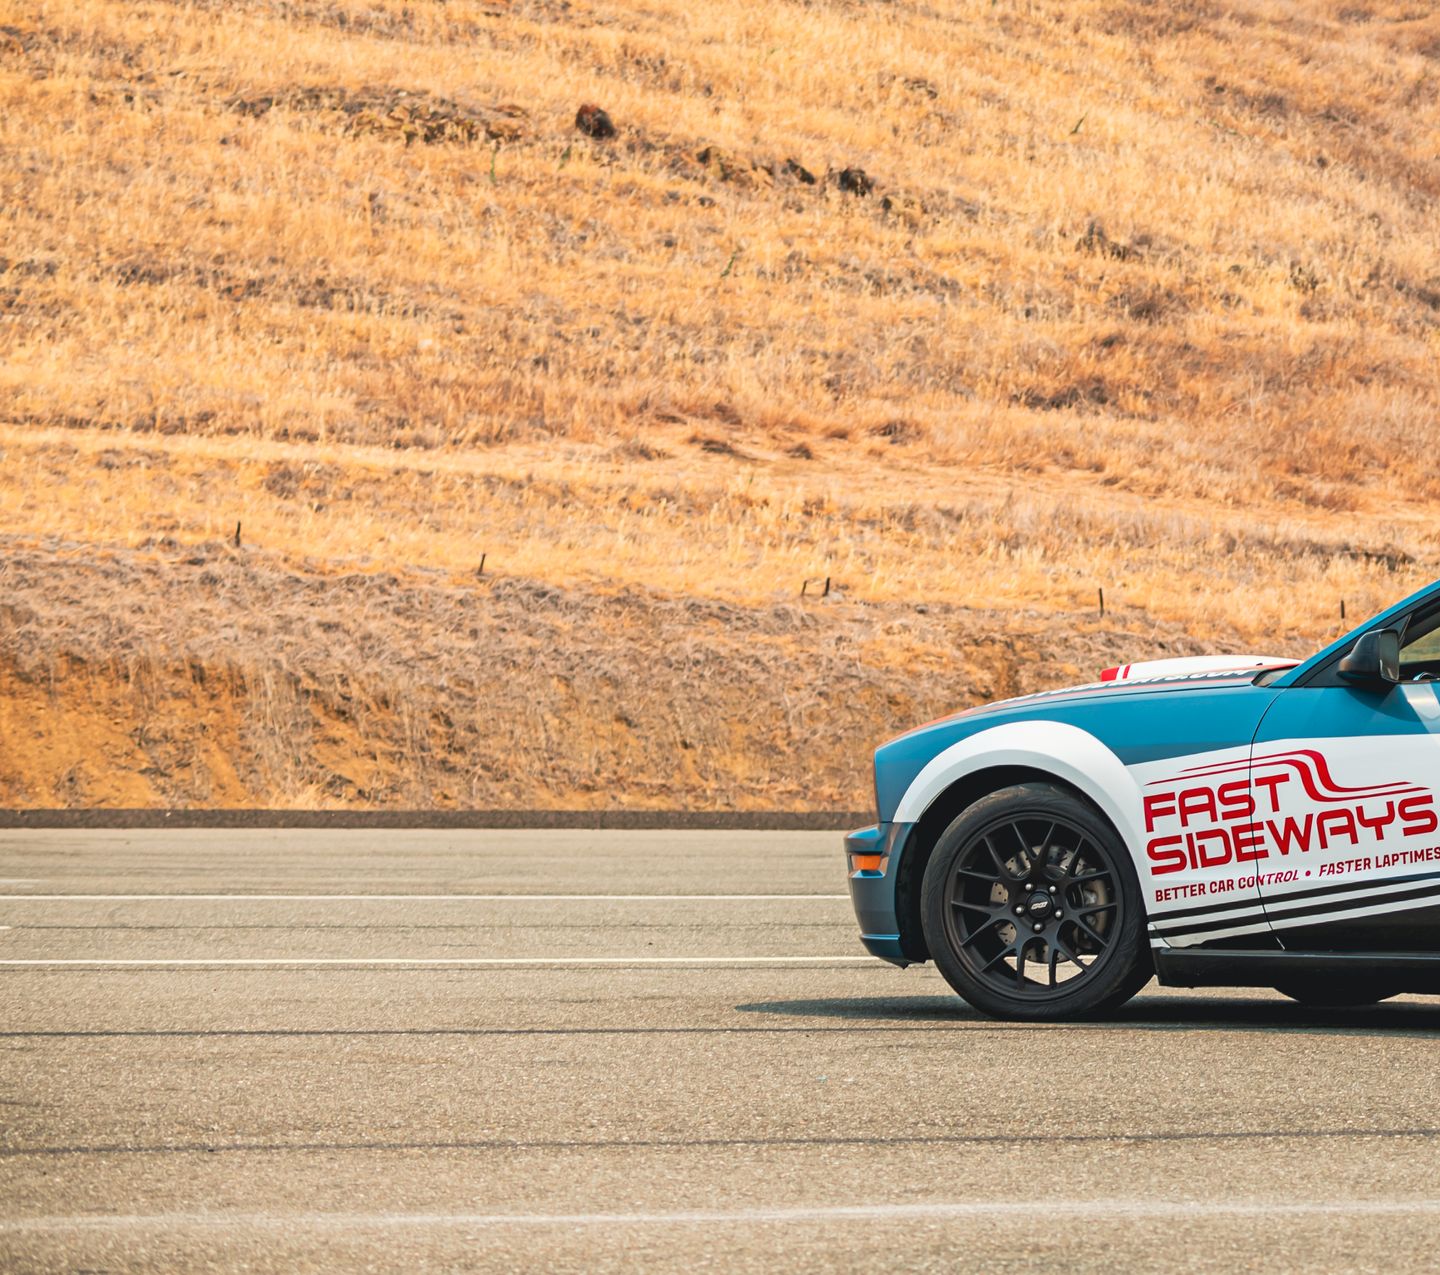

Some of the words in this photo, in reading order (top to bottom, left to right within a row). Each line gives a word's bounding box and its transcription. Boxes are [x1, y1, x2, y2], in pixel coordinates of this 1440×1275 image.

[1143, 773, 1290, 833] FAST
[1146, 794, 1439, 876] SIDEWAYS
[1155, 882, 1206, 902] BETTER
[1209, 878, 1235, 894] CAR
[1238, 870, 1299, 890] CONTROL
[1318, 857, 1371, 877] FASTER
